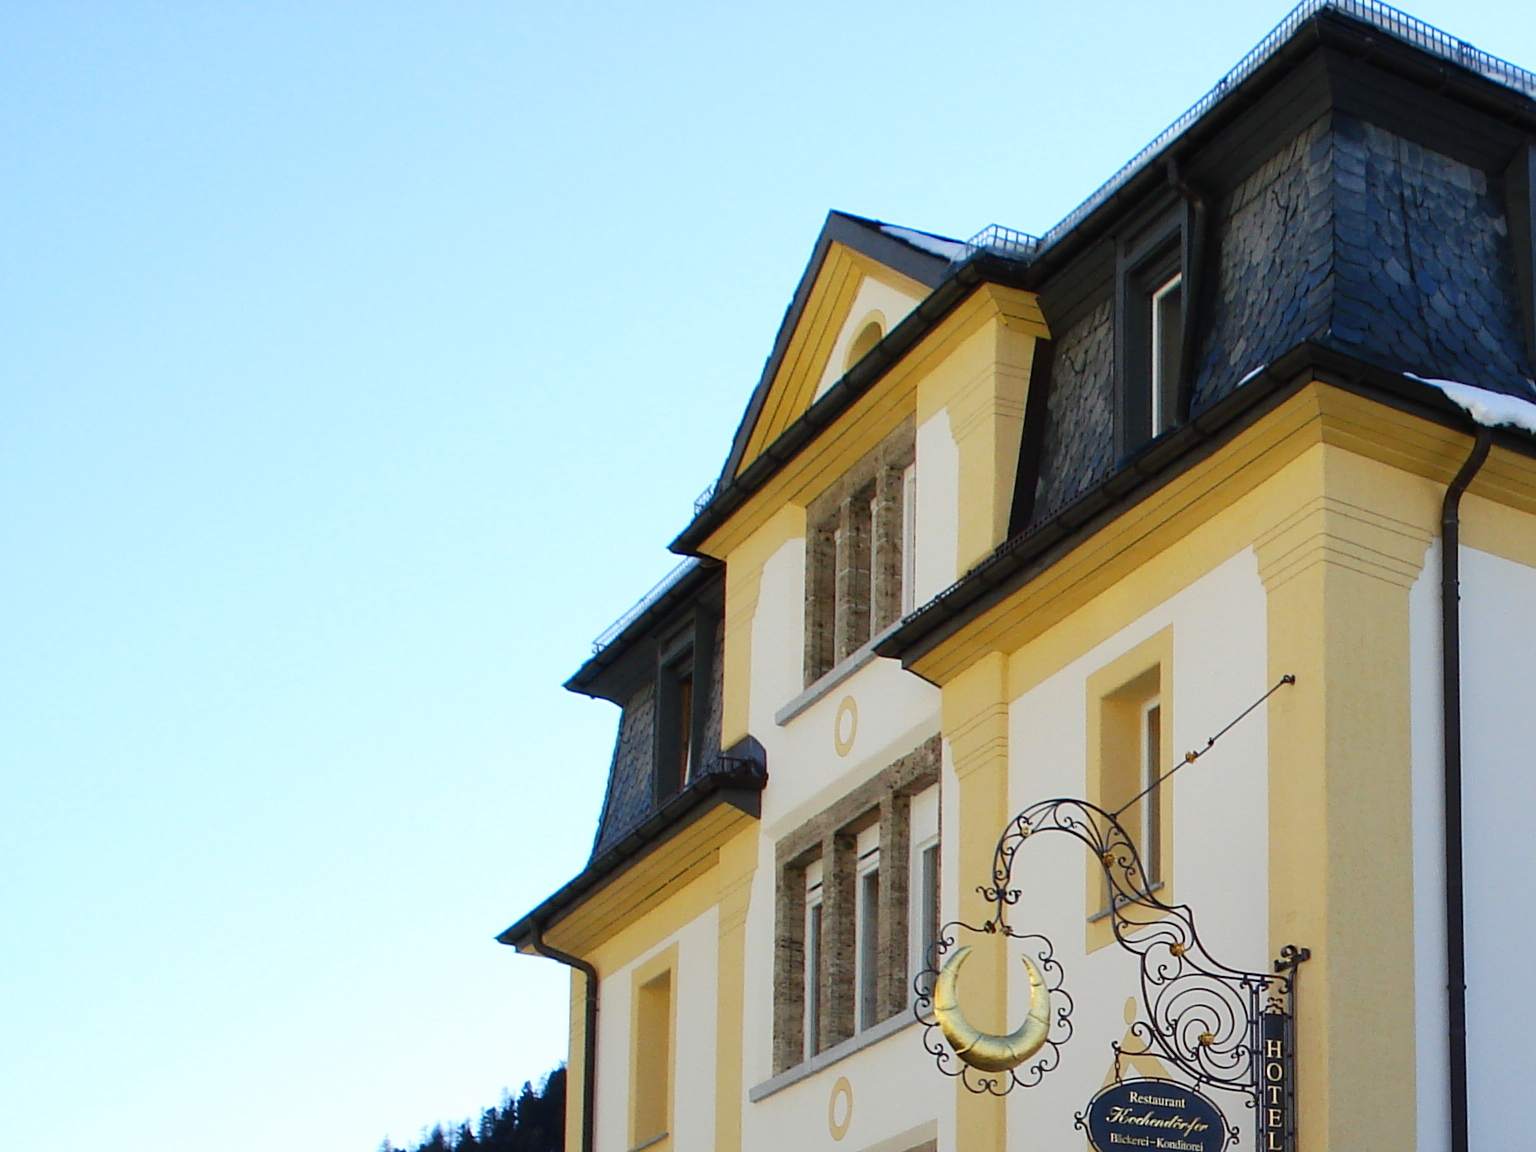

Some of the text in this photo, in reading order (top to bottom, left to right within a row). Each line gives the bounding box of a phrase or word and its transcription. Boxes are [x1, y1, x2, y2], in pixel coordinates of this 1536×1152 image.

[1129, 1091, 1186, 1109] Restaurant
[1265, 1040, 1283, 1151] HOTEL
[1105, 1106, 1209, 1137] Kochendörfer
